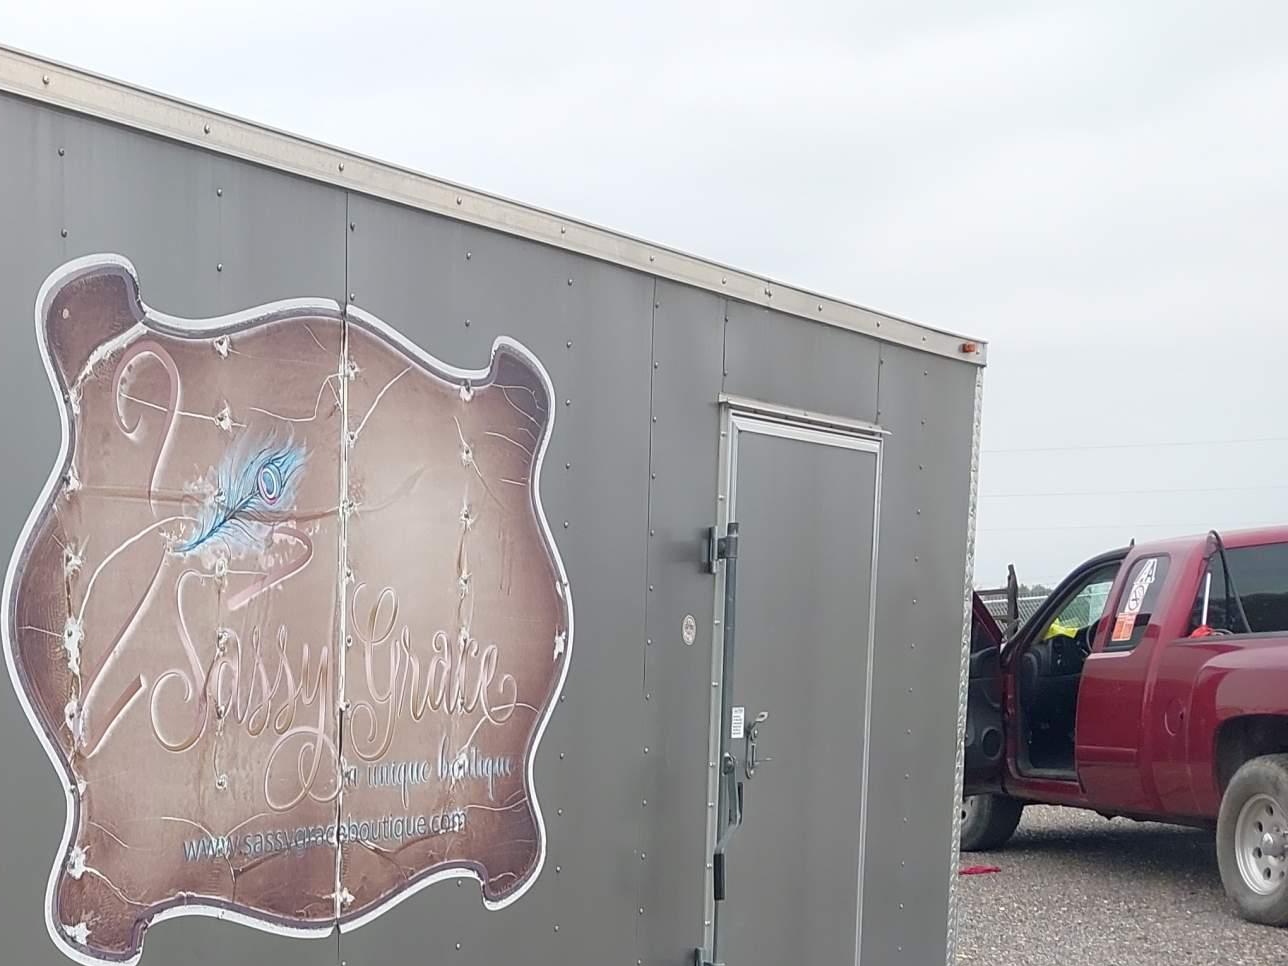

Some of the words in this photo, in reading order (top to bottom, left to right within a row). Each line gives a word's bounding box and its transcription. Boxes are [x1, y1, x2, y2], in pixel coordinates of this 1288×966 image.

[150, 568, 344, 812] Sassy
[350, 581, 518, 762] Grace
[367, 759, 433, 809] unique
